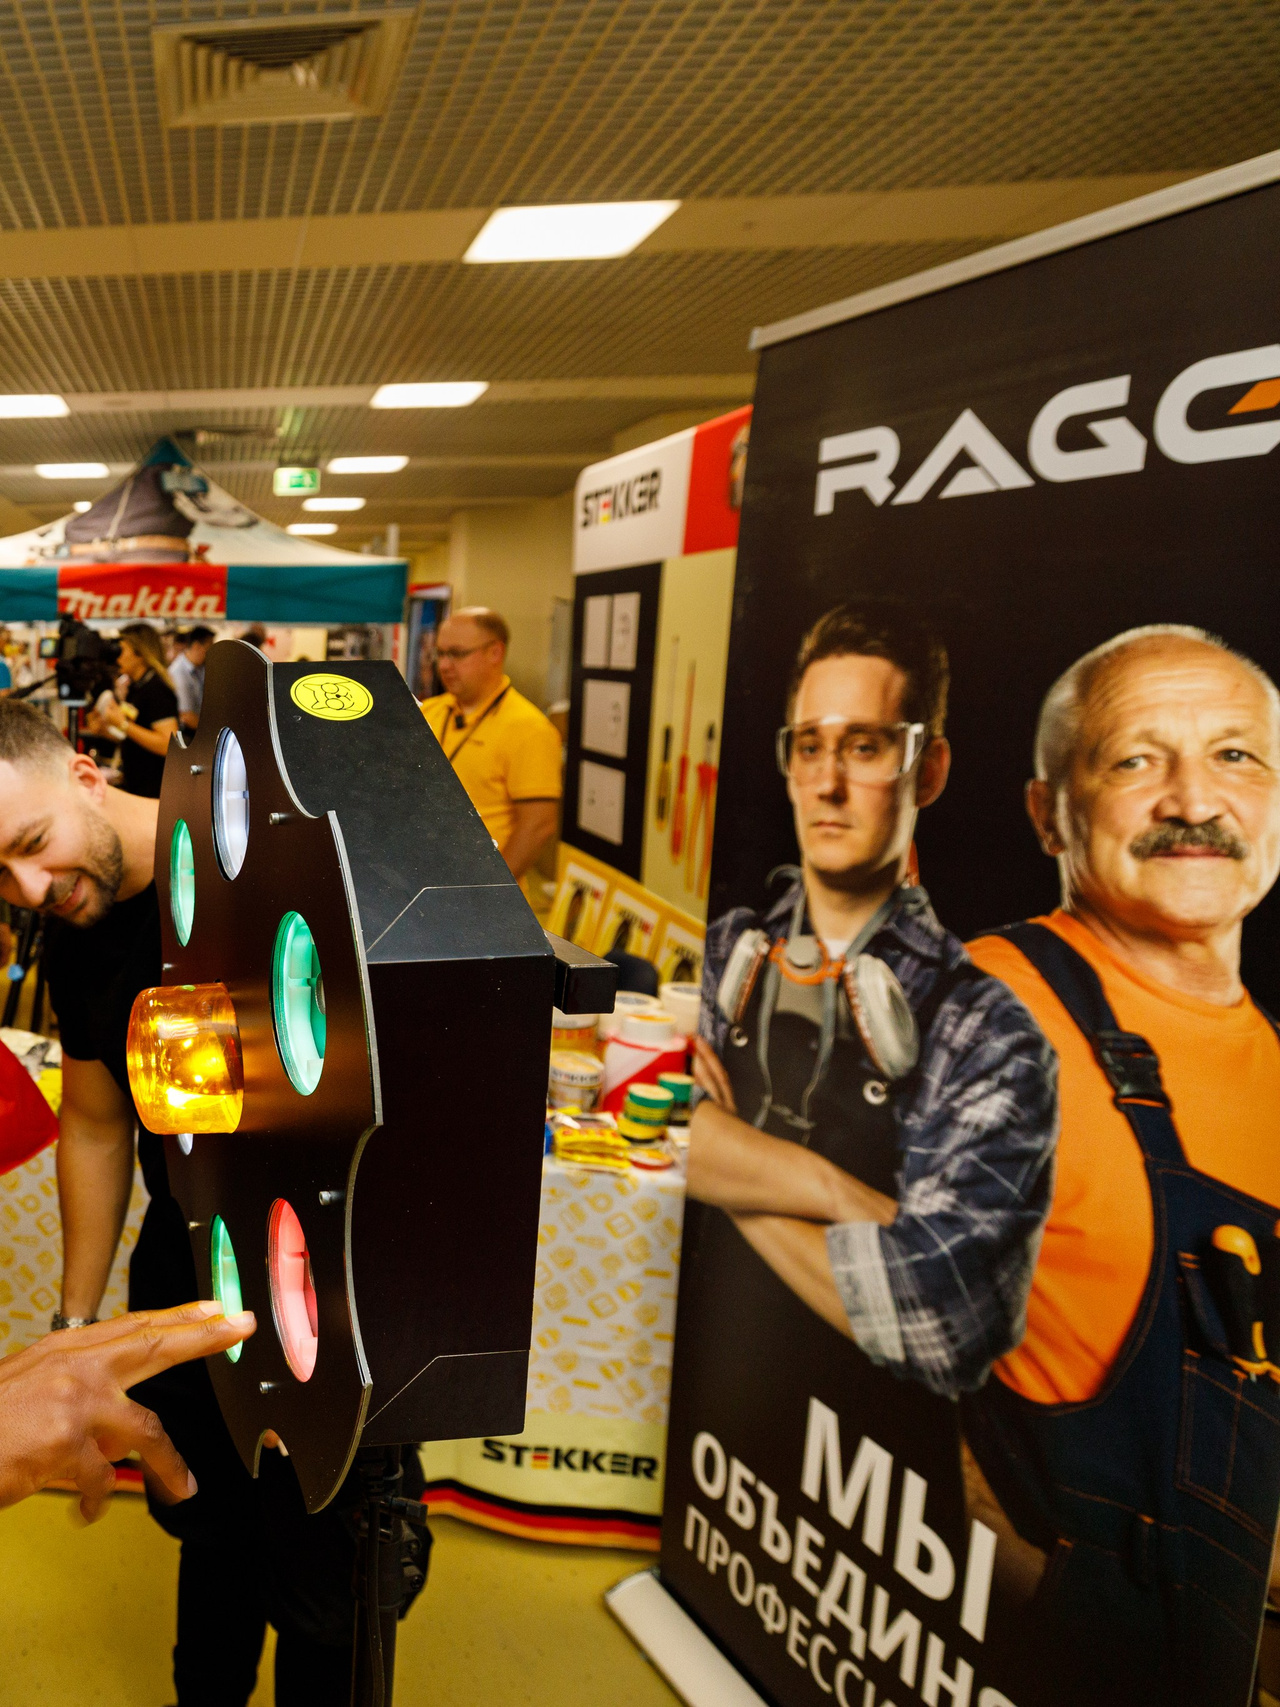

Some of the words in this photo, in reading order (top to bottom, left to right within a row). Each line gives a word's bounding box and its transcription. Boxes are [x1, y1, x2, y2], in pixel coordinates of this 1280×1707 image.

[583, 470, 660, 529] STEKKER
[482, 1438, 658, 1480] STEKKER
[800, 1395, 998, 1644] МЫ
[691, 1431, 1019, 1707] ОБЪЕДИН
